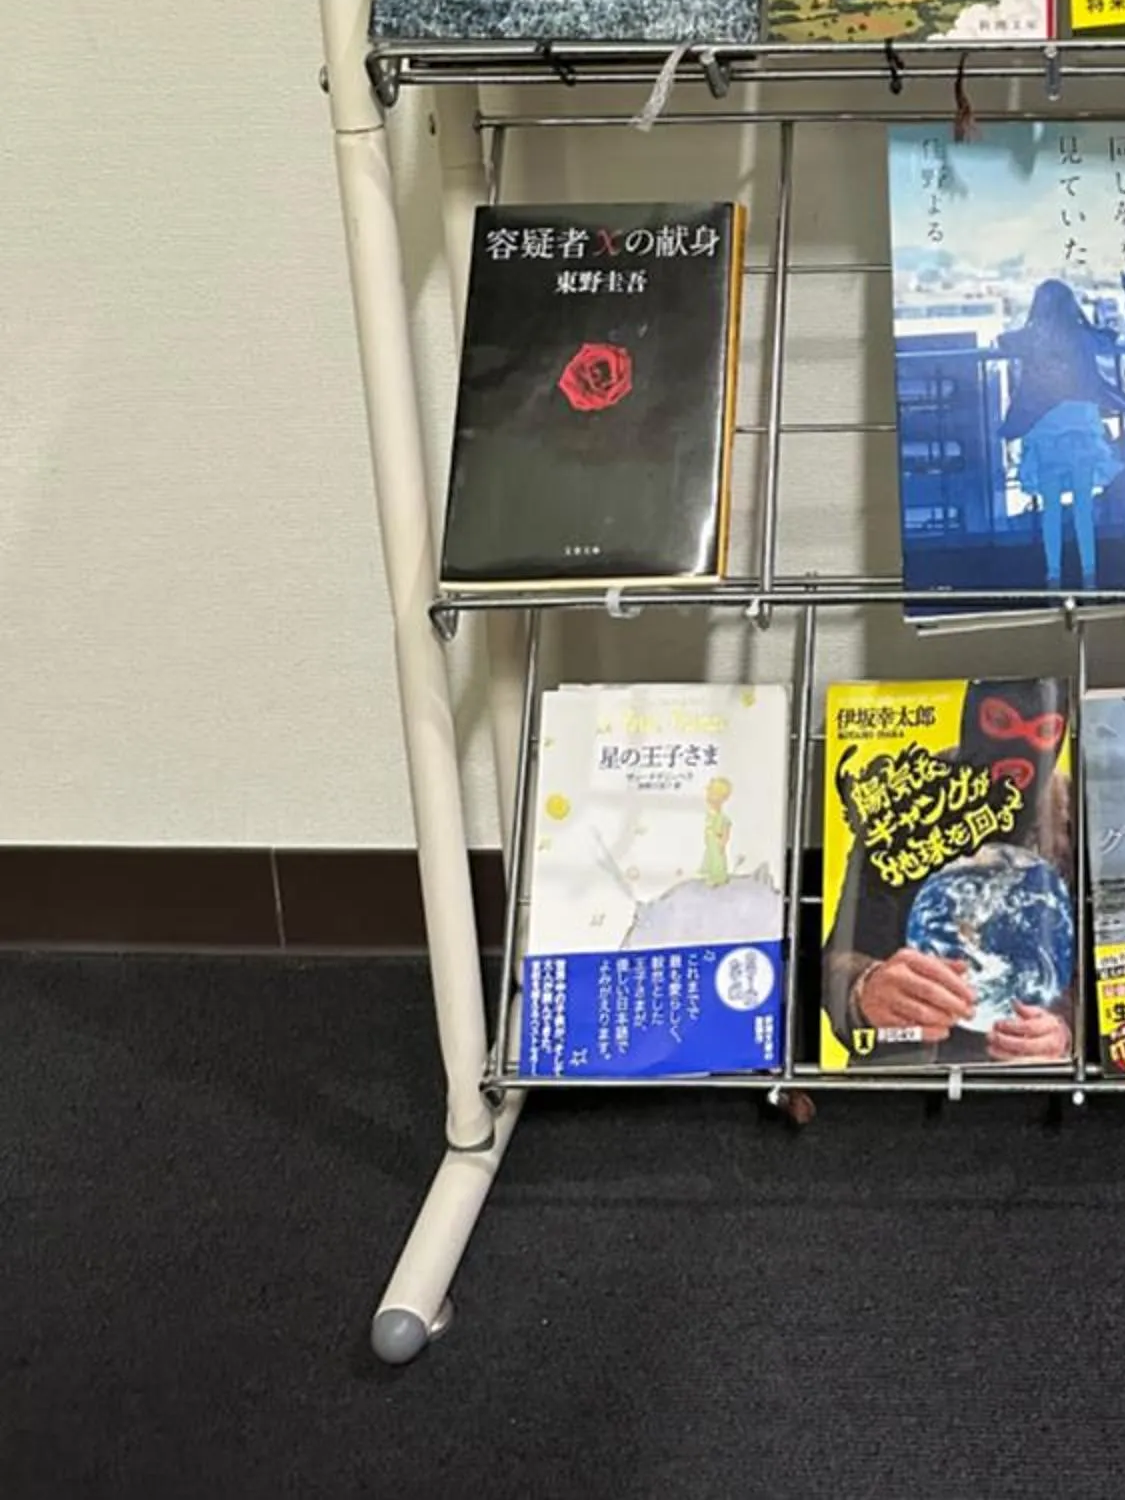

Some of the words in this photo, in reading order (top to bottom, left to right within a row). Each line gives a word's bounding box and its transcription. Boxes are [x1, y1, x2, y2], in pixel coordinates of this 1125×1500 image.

[1059, 136, 1087, 264] 見ていた
[485, 224, 720, 260] 容疑者Xの献身
[555, 270, 648, 294] 東野圭吾
[837, 705, 937, 729] 伊坂幸太郎
[599, 744, 719, 769] 星の王子さま
[864, 765, 990, 848] ギャングが
[870, 778, 1025, 886] 地球を回す
